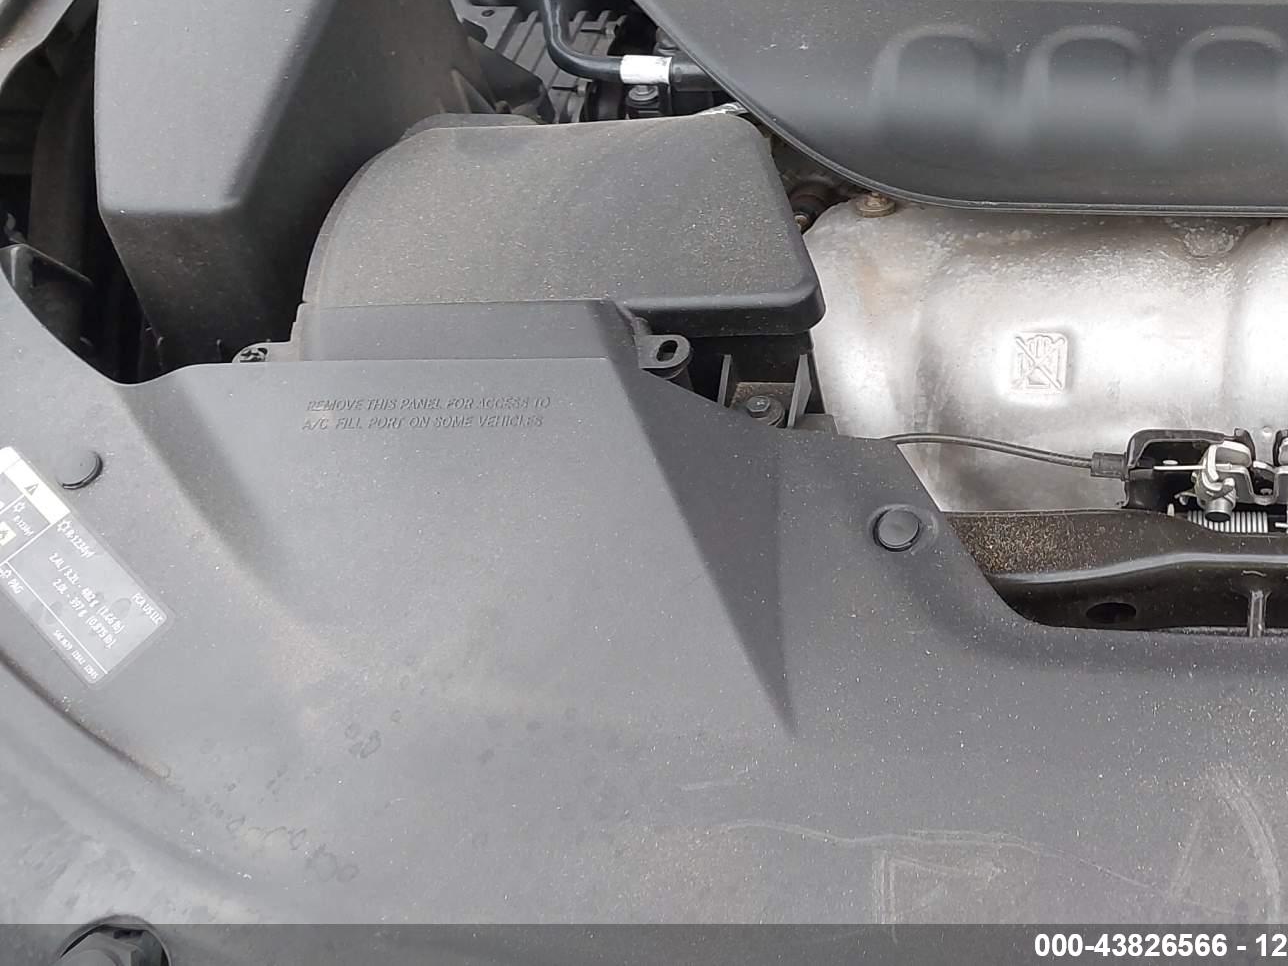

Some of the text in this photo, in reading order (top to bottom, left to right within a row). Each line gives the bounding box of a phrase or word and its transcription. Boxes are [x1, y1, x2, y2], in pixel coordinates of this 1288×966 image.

[305, 396, 551, 412] REMOVE THIS PANEL FOR ACCESS TO
[302, 415, 544, 430] A/C FILL PORT ON SOME VEHICLES
